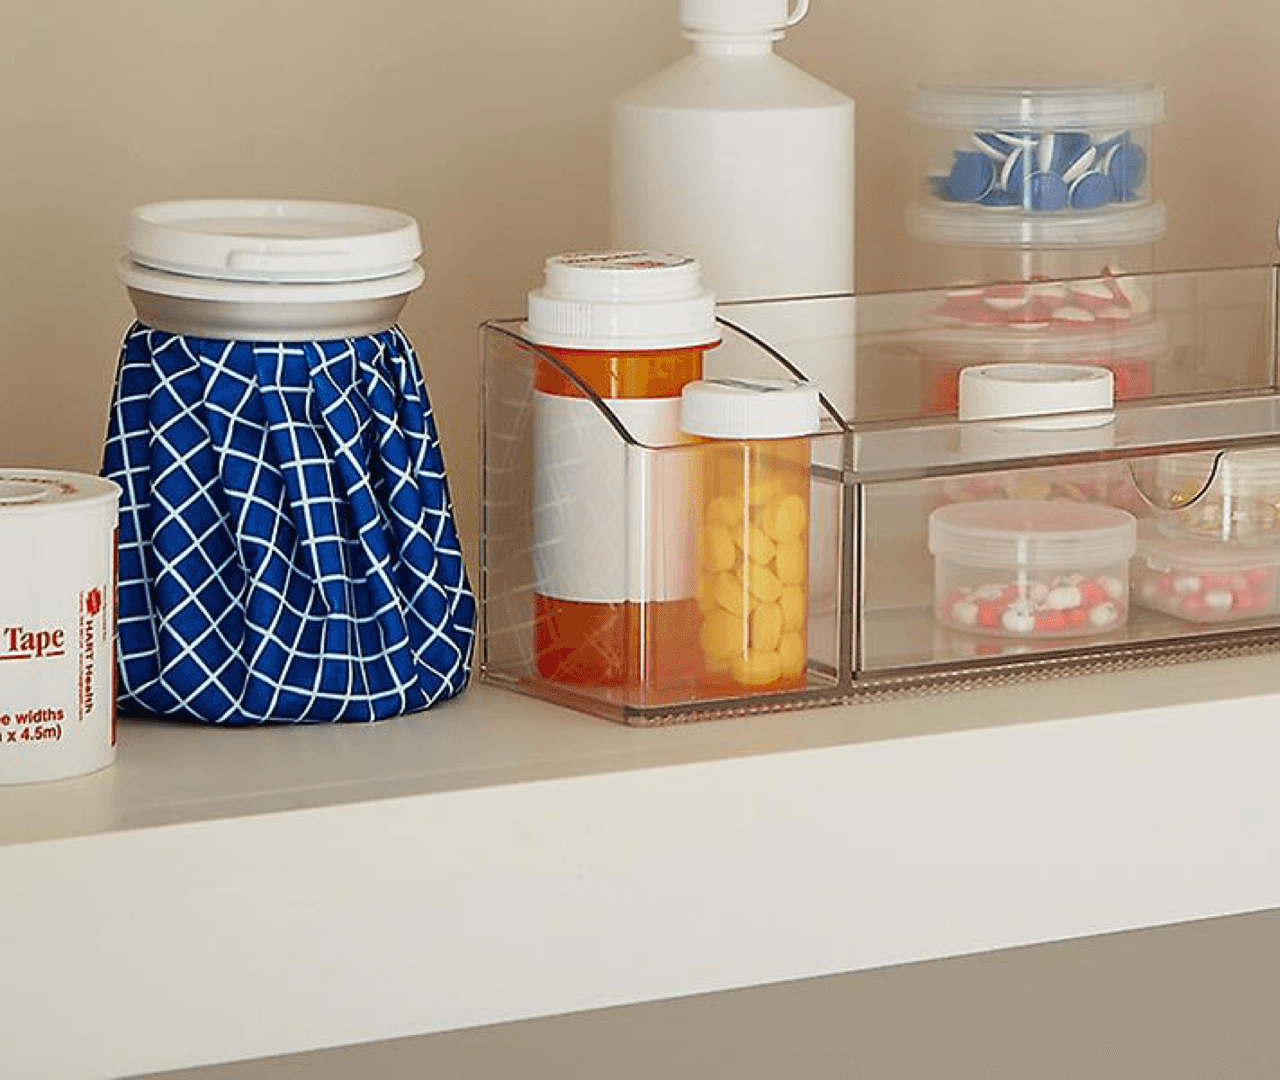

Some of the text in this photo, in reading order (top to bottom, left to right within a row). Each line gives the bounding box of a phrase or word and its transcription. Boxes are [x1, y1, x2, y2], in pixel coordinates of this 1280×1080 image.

[4, 627, 64, 658] Tape
[16, 708, 64, 724] widths
[7, 724, 62, 742] x 4.5m)
